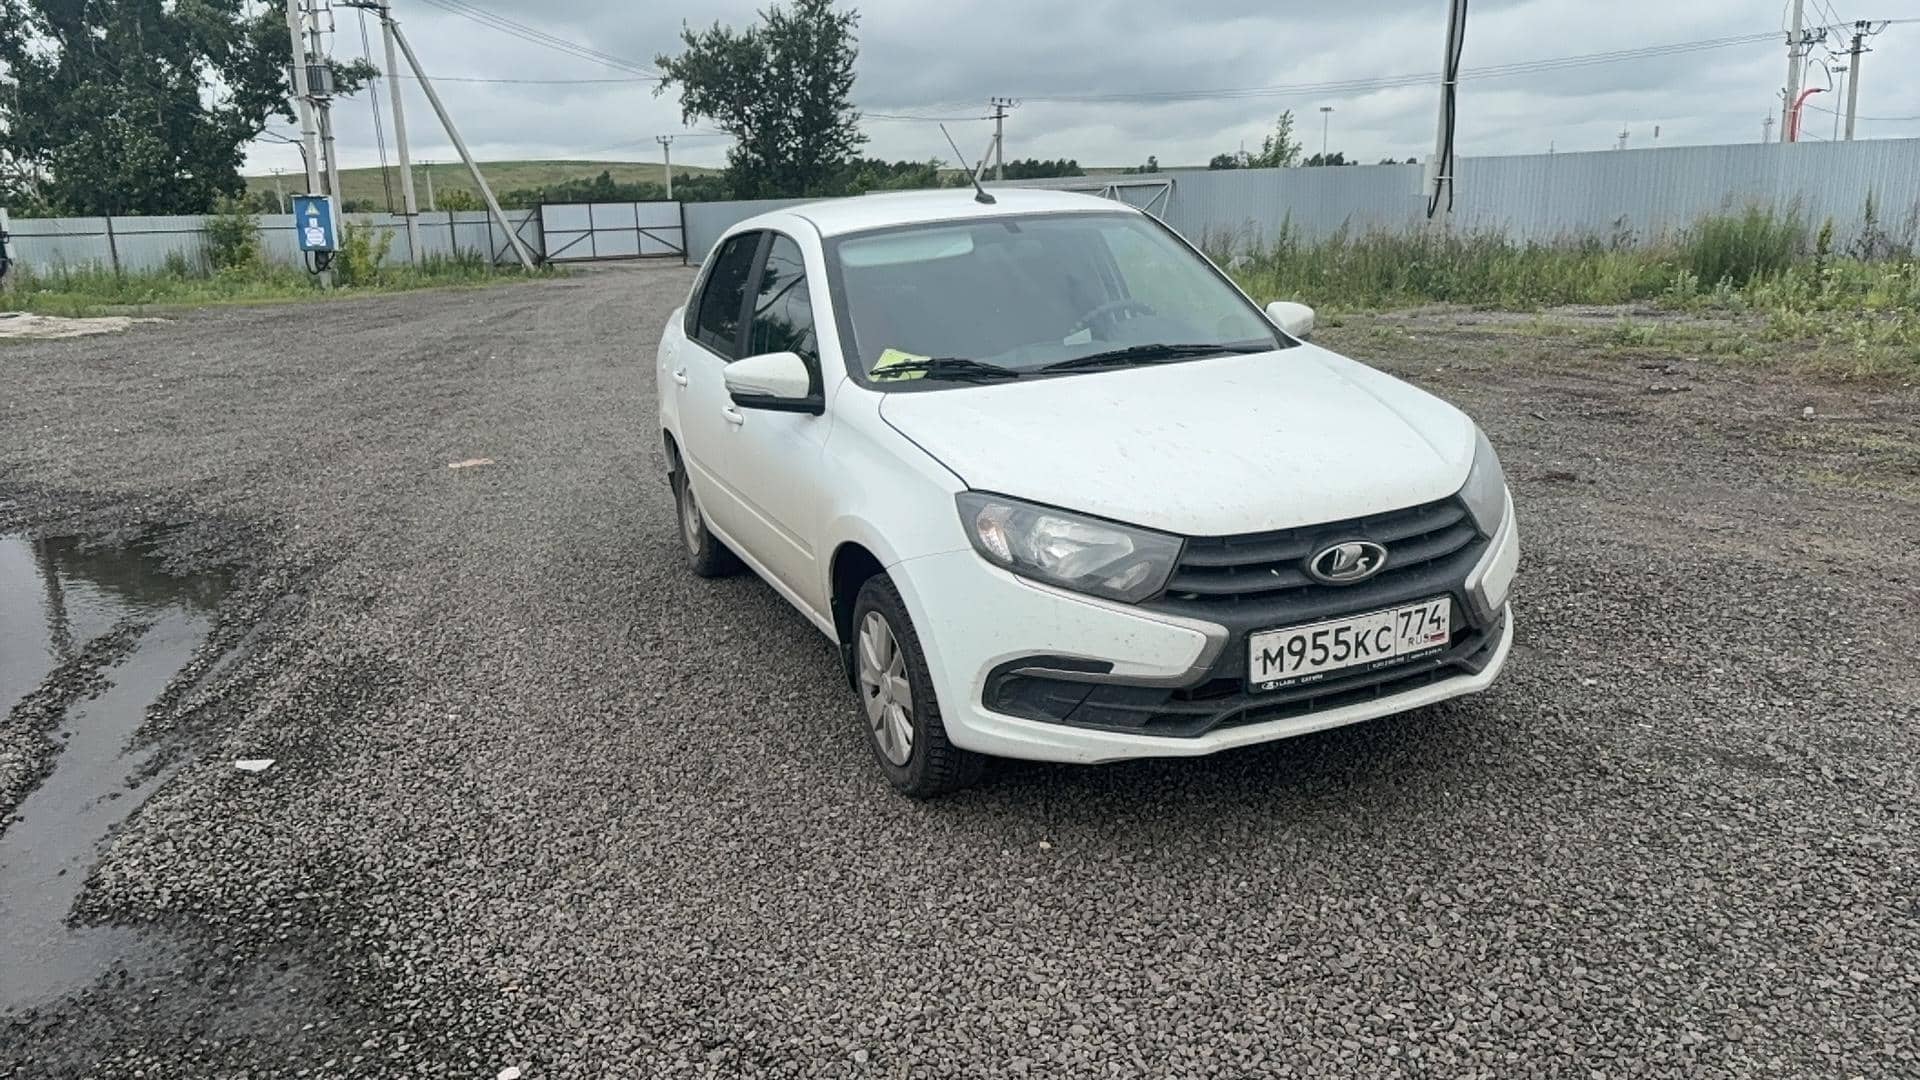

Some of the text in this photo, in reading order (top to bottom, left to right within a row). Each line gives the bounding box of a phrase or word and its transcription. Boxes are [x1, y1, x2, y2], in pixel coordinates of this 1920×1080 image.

[1262, 604, 1442, 675] М955КС 774
[1408, 634, 1430, 647] RUS
